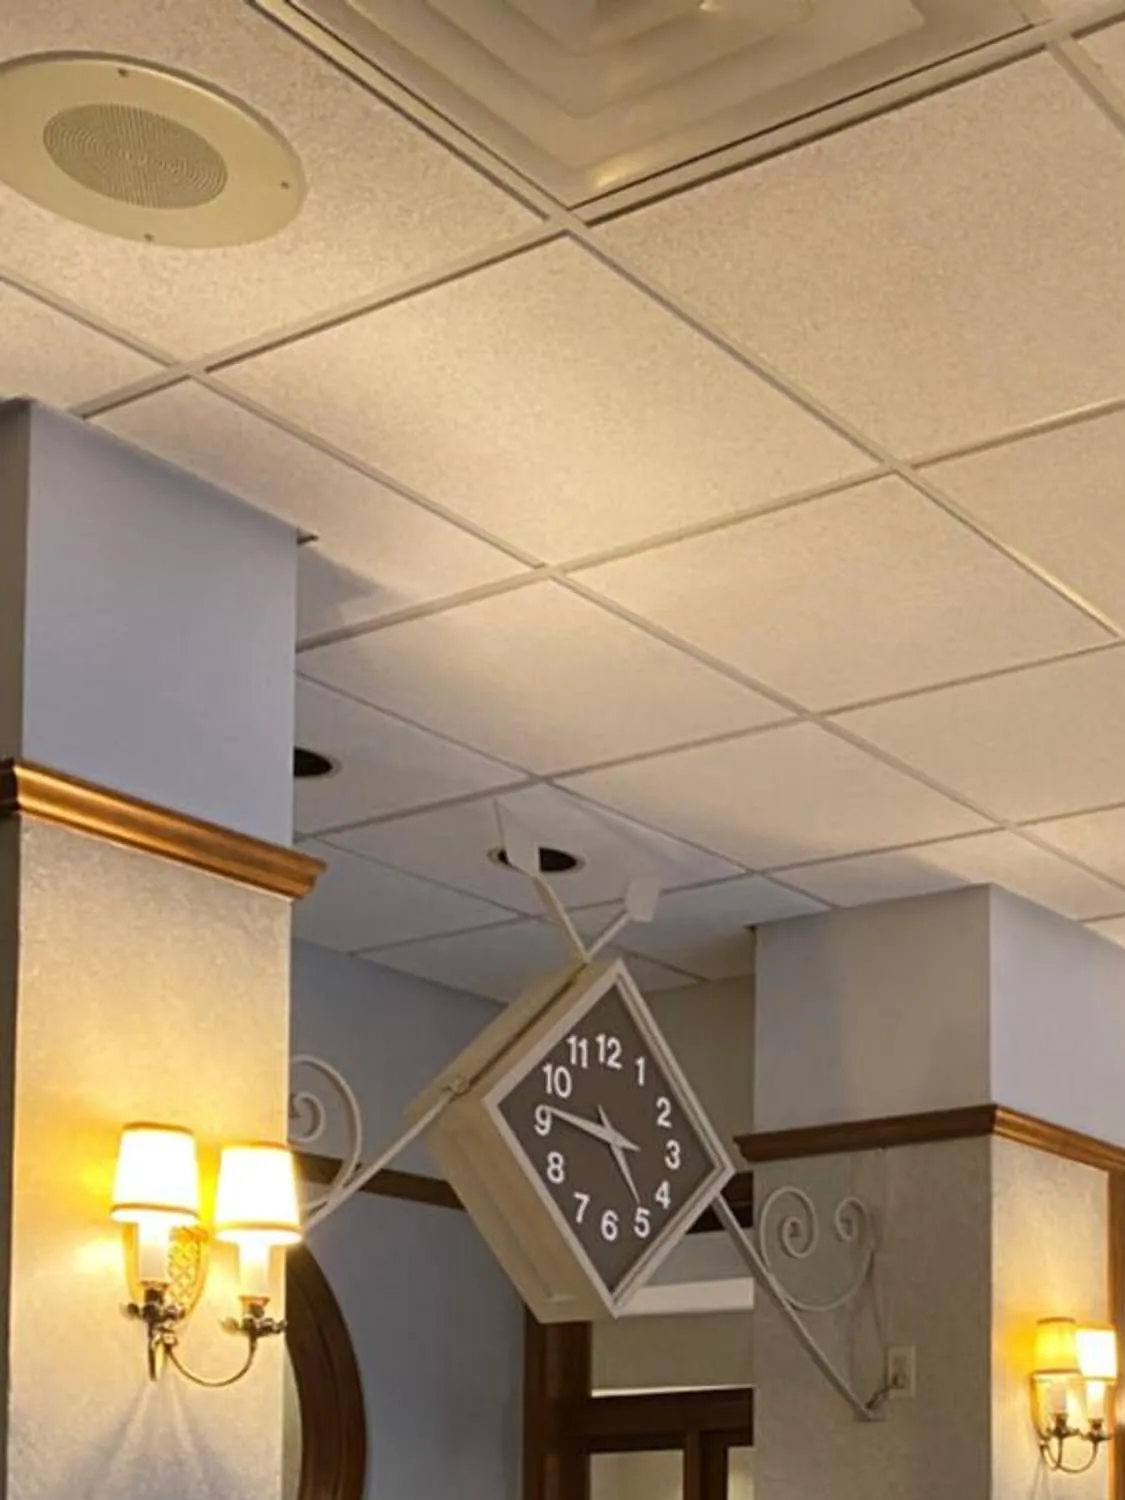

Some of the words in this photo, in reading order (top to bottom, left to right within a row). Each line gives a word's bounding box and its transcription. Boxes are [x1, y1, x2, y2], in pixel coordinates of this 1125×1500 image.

[567, 1035, 589, 1069] 11
[596, 1034, 622, 1069] 12
[543, 1063, 572, 1098] 10
[636, 1057, 646, 1086] 1
[534, 1104, 552, 1136] 9
[656, 1097, 672, 1128] 2
[546, 1151, 565, 1184] 8
[665, 1139, 681, 1170] 3
[573, 1191, 590, 1223] 7
[655, 1180, 671, 1209] 4
[600, 1209, 618, 1242] 6
[633, 1207, 651, 1238] 5
